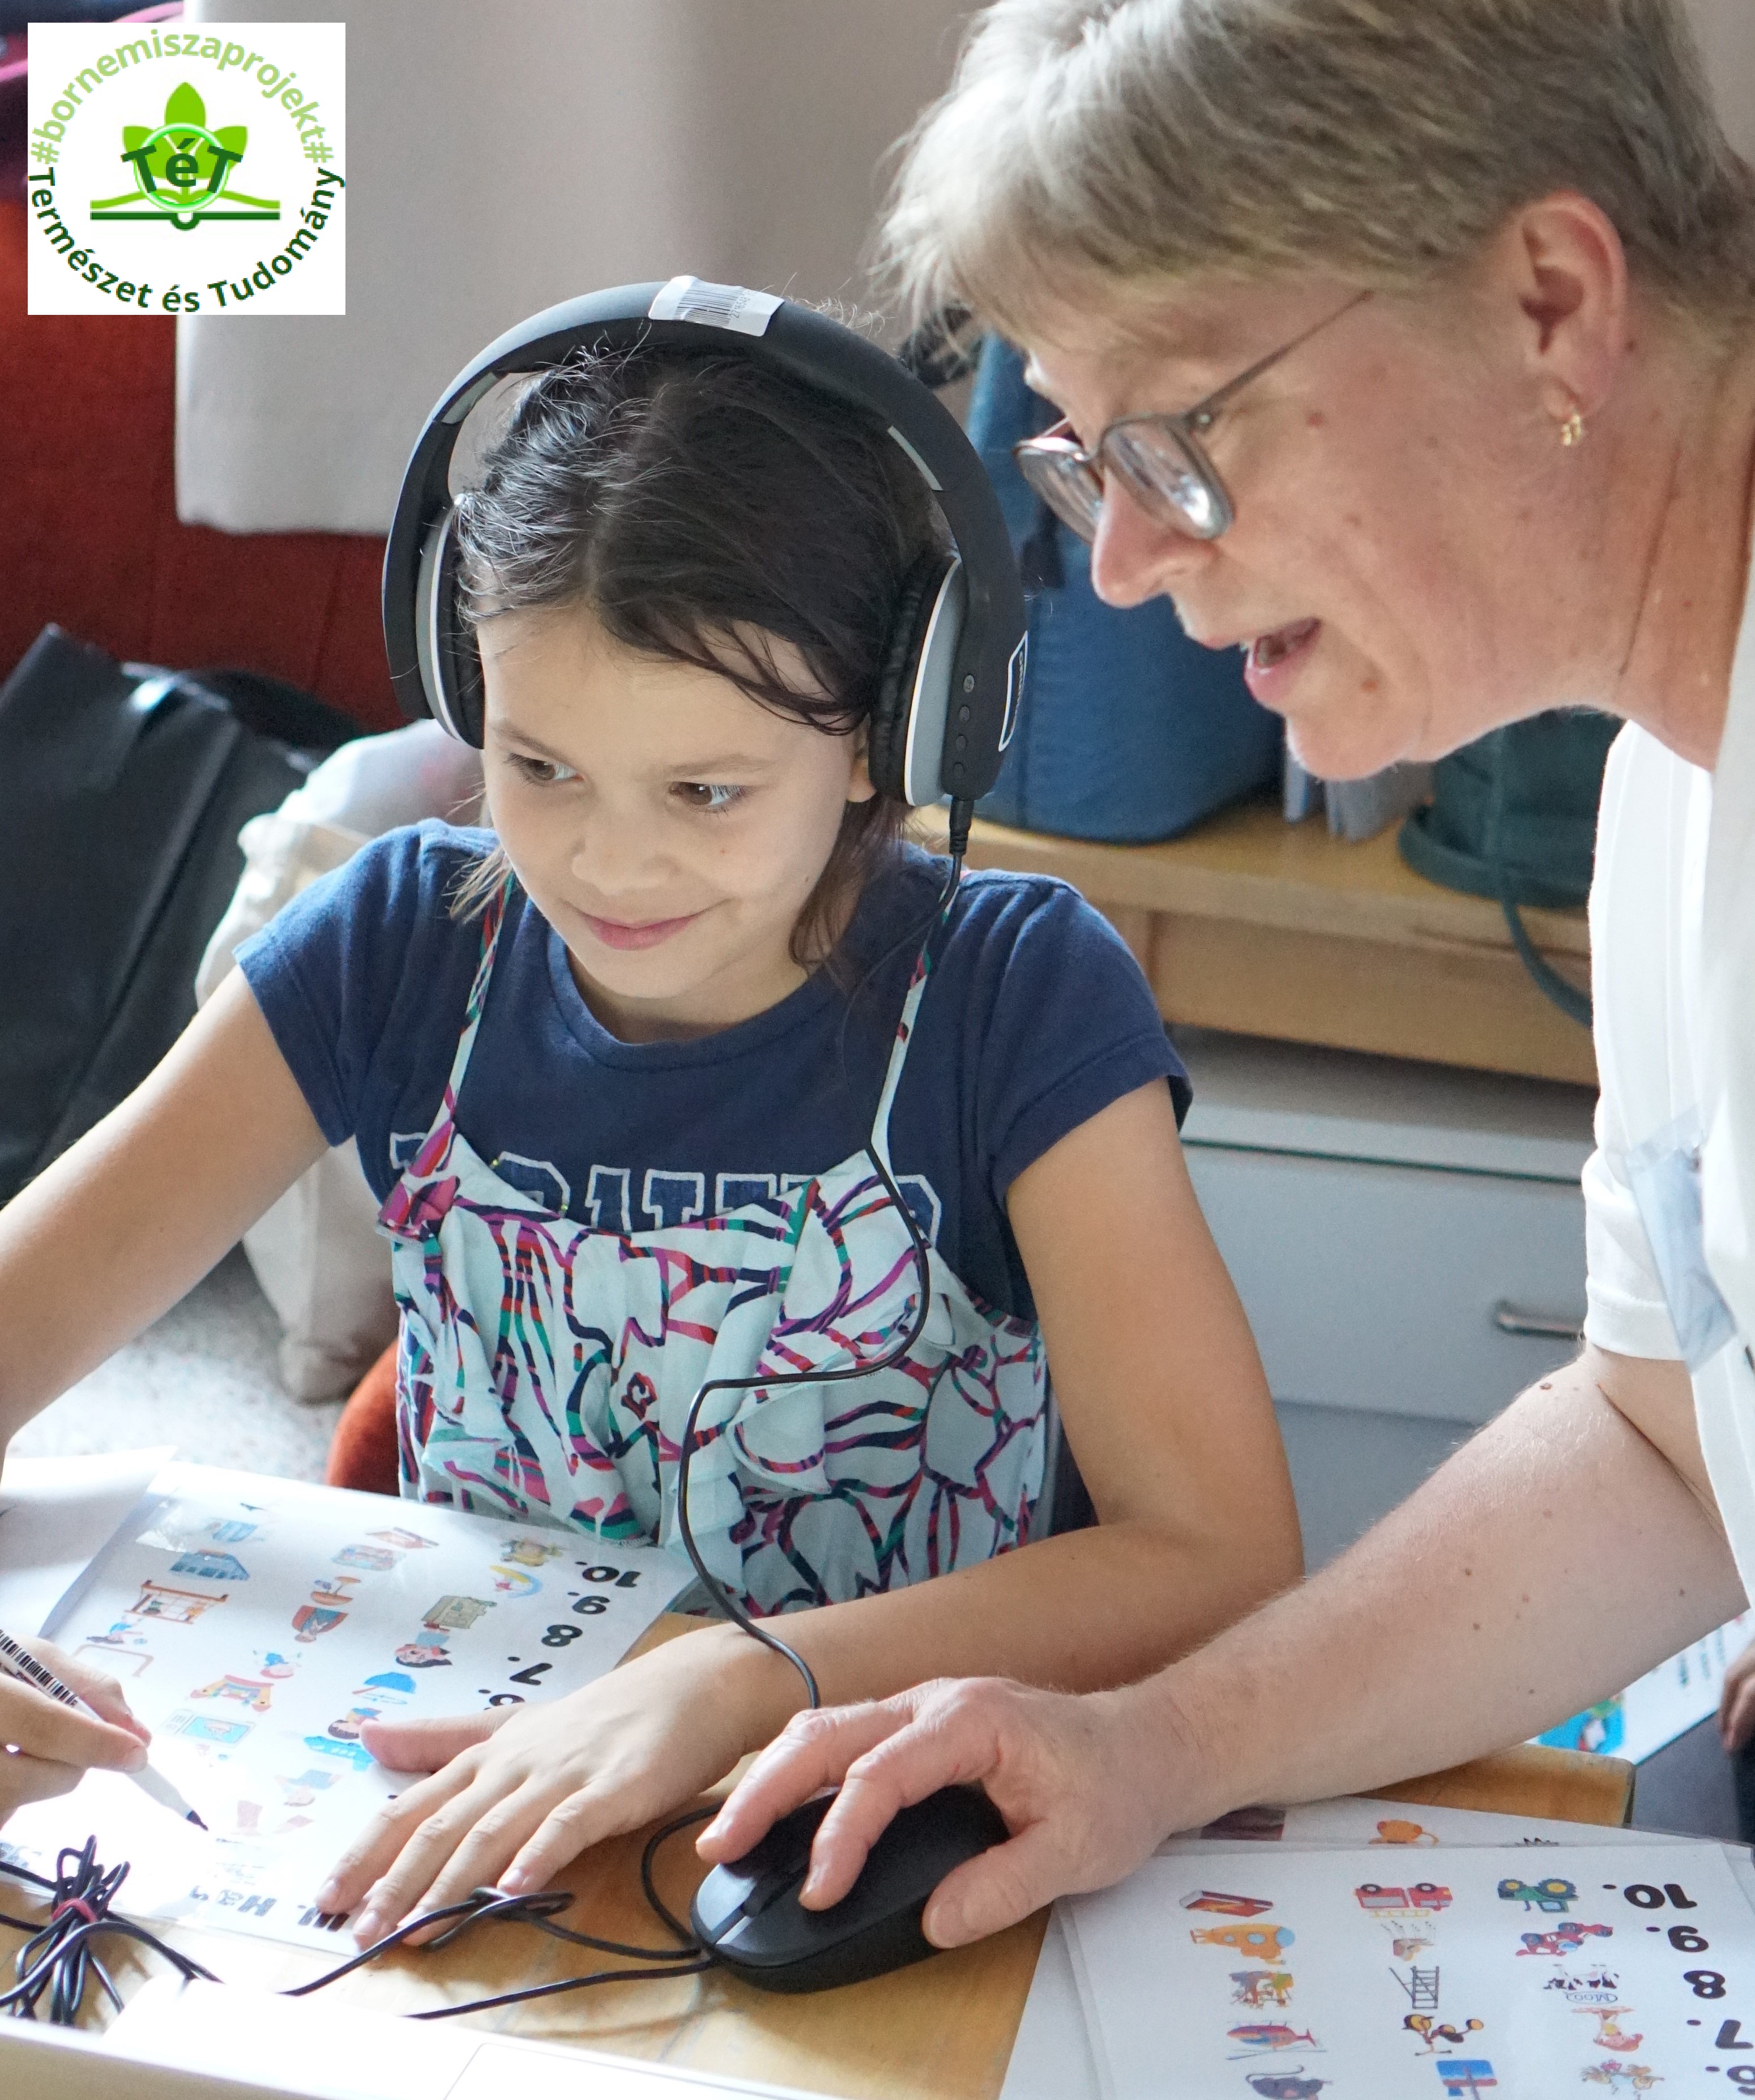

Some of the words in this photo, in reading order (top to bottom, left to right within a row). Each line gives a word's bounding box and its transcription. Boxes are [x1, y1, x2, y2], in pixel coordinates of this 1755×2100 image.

[1603, 1884, 1698, 1909] 10.
[1646, 1926, 1709, 1953] 9.
[1687, 2020, 1754, 2050] 7.
